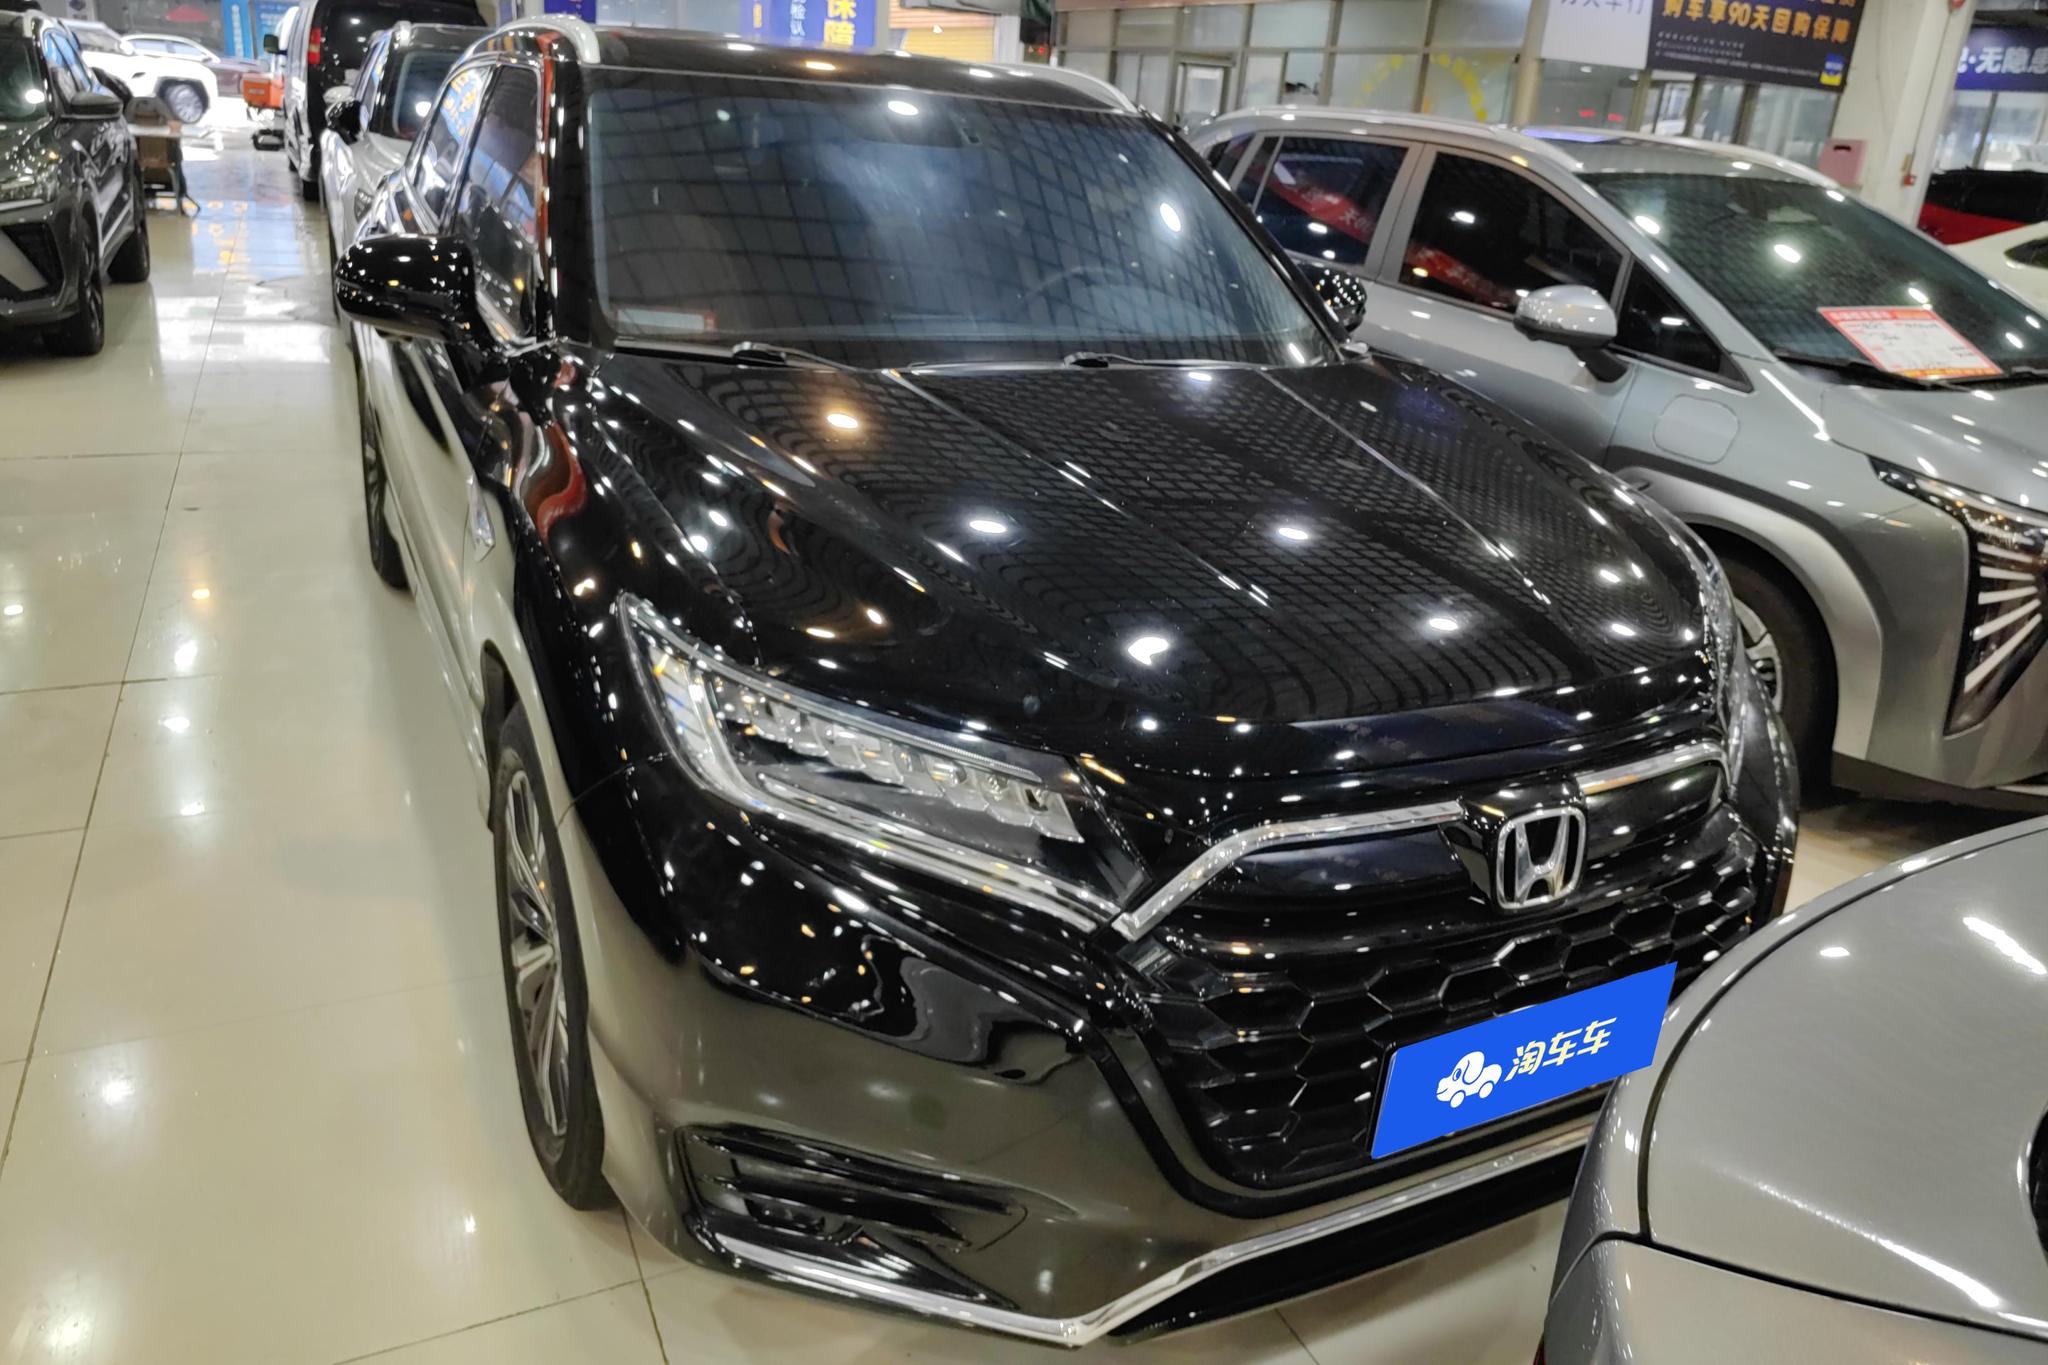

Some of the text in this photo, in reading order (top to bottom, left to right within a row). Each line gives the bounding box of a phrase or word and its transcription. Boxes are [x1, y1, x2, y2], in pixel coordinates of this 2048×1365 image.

[1662, 0, 1851, 43] 购车享90天回购保障
